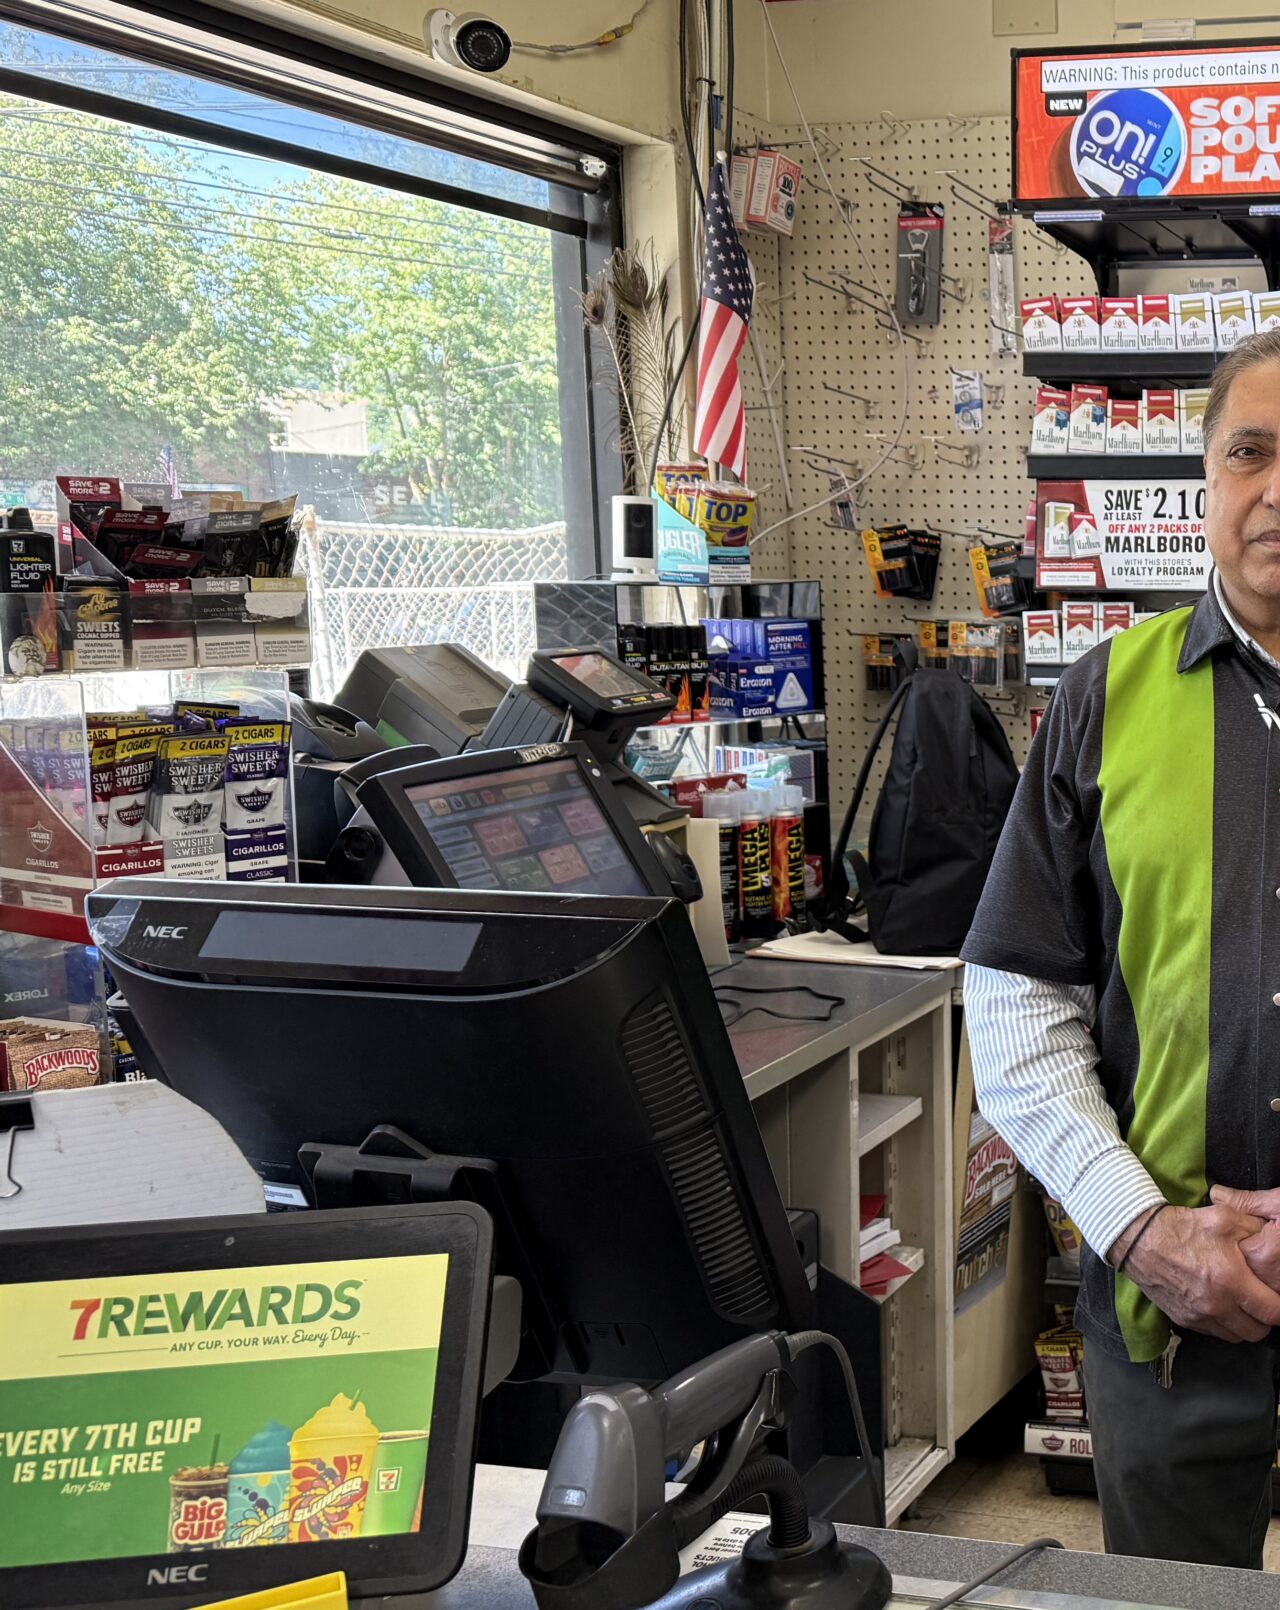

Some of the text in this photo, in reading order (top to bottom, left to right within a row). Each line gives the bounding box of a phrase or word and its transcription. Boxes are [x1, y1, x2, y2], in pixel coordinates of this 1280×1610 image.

[1044, 67, 1117, 84] WARNING:
[1121, 65, 1148, 81] This
[1153, 63, 1205, 82] product
[1209, 60, 1267, 78] contains
[1050, 99, 1083, 111] NEW
[1089, 110, 1157, 165] on!
[1080, 142, 1140, 180] PLUS
[1025, 331, 1060, 349] Marlboro
[1064, 331, 1098, 348] Marlboro
[1103, 331, 1137, 348] Marlboro
[1140, 330, 1174, 348] Marlboro
[1180, 330, 1210, 347] Marlboro
[69, 480, 94, 488] SAVE
[69, 487, 94, 495] MORE
[1104, 489, 1143, 511] SAVE
[1145, 488, 1150, 498] $
[705, 500, 748, 523] TOP
[1103, 512, 1143, 521] AT LEAST
[1108, 523, 1203, 534] OFF ANY 2 PACKS OF
[657, 530, 702, 560] UGLER
[1105, 536, 1206, 554] MARLBORO
[10, 563, 52, 572] LIGHTER
[1124, 558, 1192, 566] WITH THIS STORE'S
[11, 572, 41, 580] FLUID
[1111, 566, 1204, 576] LOYALTY PROGRAM
[767, 635, 803, 644] MORNING
[793, 642, 807, 650] PILL
[740, 677, 773, 688] Eroxon
[234, 728, 275, 741] 2 CIGARS
[180, 739, 226, 751] 2 CIGARS
[228, 750, 280, 763] SWISHER
[168, 763, 222, 776] SWISHER
[231, 760, 277, 774] SWEETS
[171, 773, 219, 786] SWEETS
[175, 846, 214, 857] SWEETS
[232, 842, 285, 856] CIGARILLOS
[101, 858, 162, 872] CIGARILLOS
[246, 869, 275, 880] CLASSIC
[142, 924, 190, 940] NEC
[25, 1049, 99, 1088] BACKWOODS
[70, 1279, 364, 1341] 7REWARDS
[170, 1326, 361, 1353] ANY CUP. YOUR WAY. Every Day.
[85, 1421, 138, 1452] 7TH
[145, 1417, 202, 1447] CUP
[13, 1451, 165, 1483] IS STILL FREE
[60, 1481, 112, 1497] Any Size
[174, 1518, 226, 1542] GULP
[146, 1563, 209, 1586] NEC
